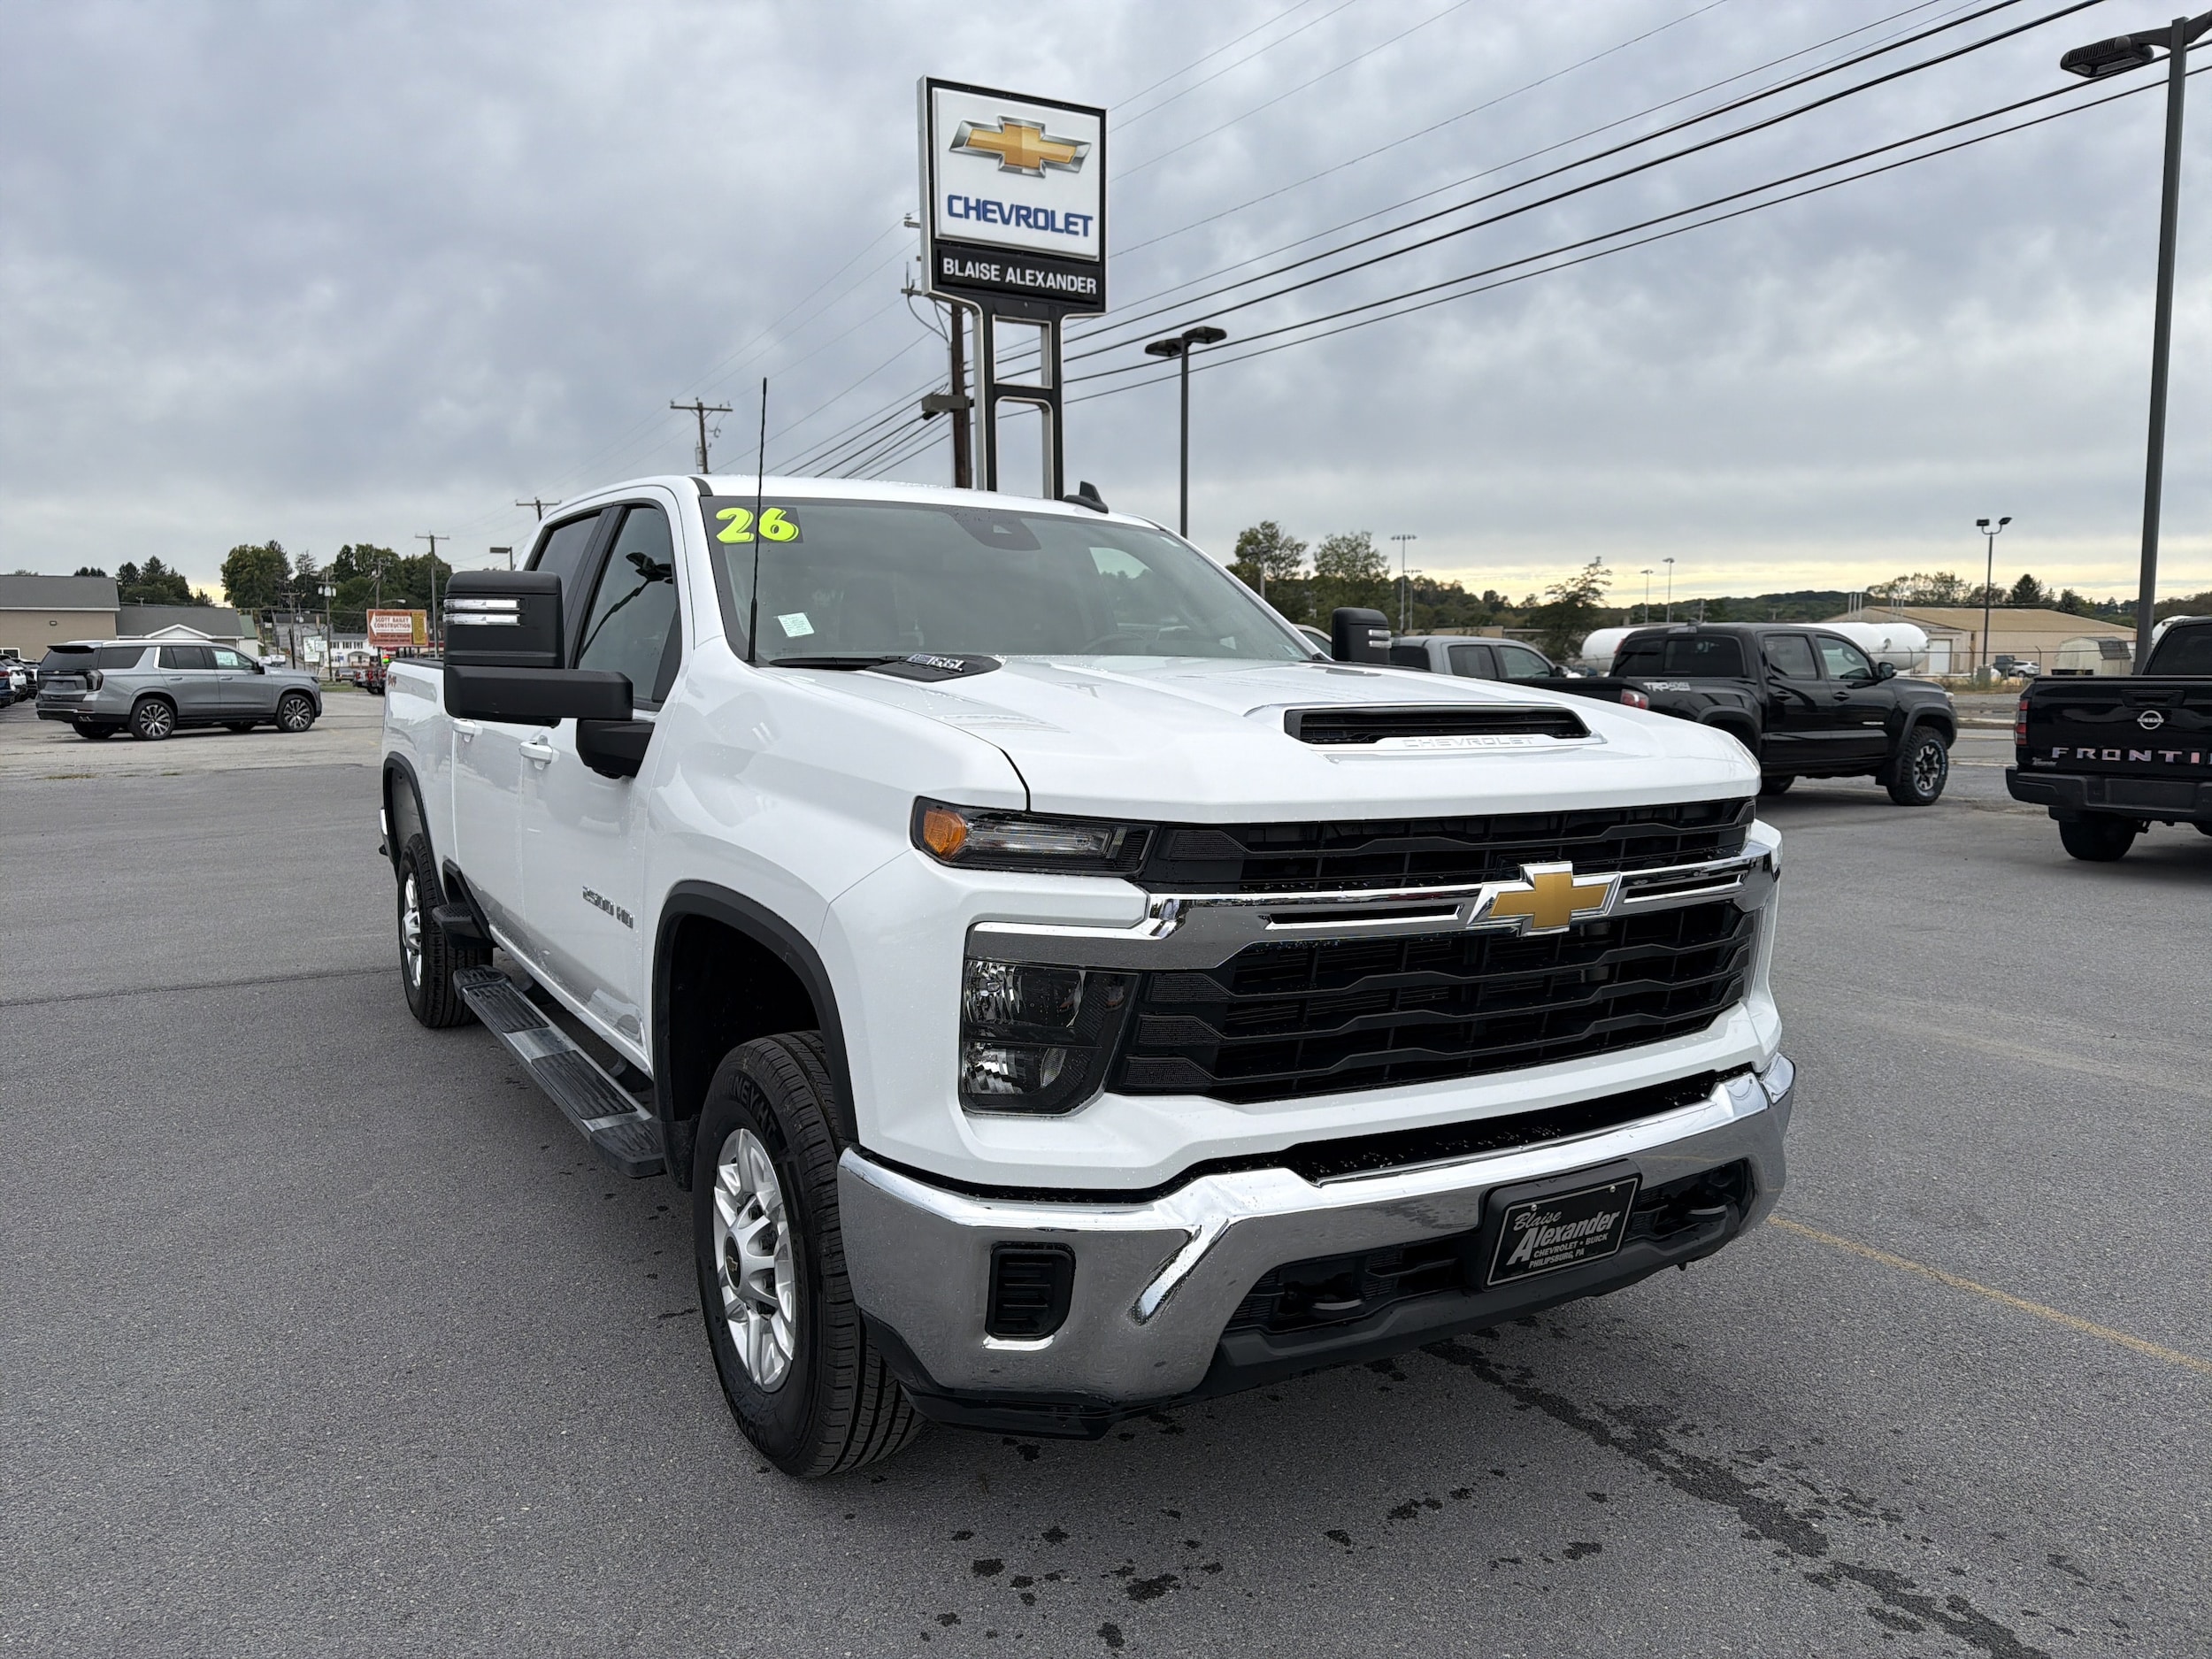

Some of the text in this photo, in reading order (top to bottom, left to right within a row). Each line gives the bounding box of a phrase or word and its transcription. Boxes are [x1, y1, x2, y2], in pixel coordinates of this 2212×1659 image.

[947, 194, 1094, 237] CHEVROLET
[942, 257, 1097, 295] BLAISE ALEXANDER
[715, 507, 799, 543] 26
[1402, 736, 1534, 748] CHEVROLET
[2051, 747, 2212, 765] FRONTI
[1513, 1211, 1563, 1231] Blaise
[1506, 1210, 1621, 1265] Alexander
[1533, 1233, 1609, 1258] CHEVROLET BUICK
[1574, 1248, 1586, 1257] PA
